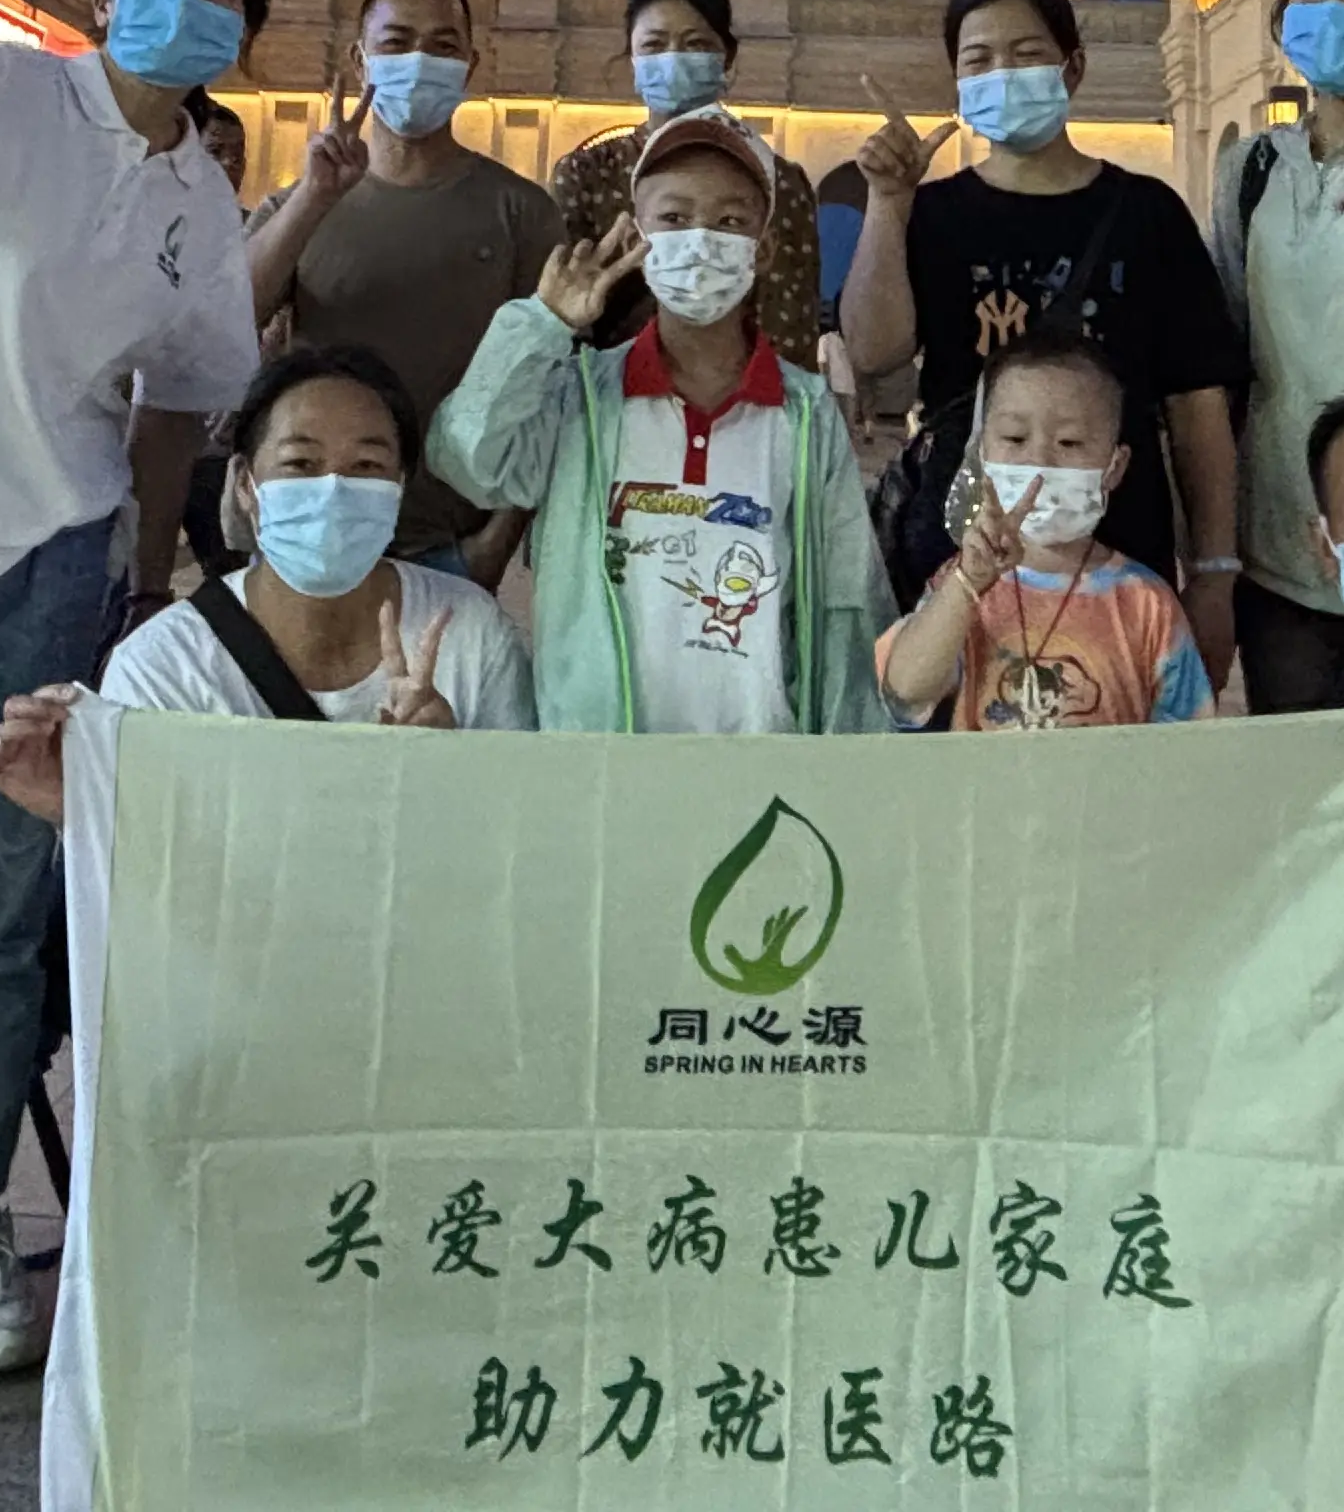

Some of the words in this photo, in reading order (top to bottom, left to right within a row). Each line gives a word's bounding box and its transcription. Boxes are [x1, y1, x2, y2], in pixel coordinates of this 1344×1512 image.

[644, 1054, 735, 1075] SPRING
[740, 1054, 765, 1074] IN
[770, 1054, 867, 1075] HEARTS
[647, 1005, 868, 1049] 同心源
[305, 1174, 1193, 1310] 关爱大病患儿家庭
[464, 1355, 1014, 1479] 助力就医路
